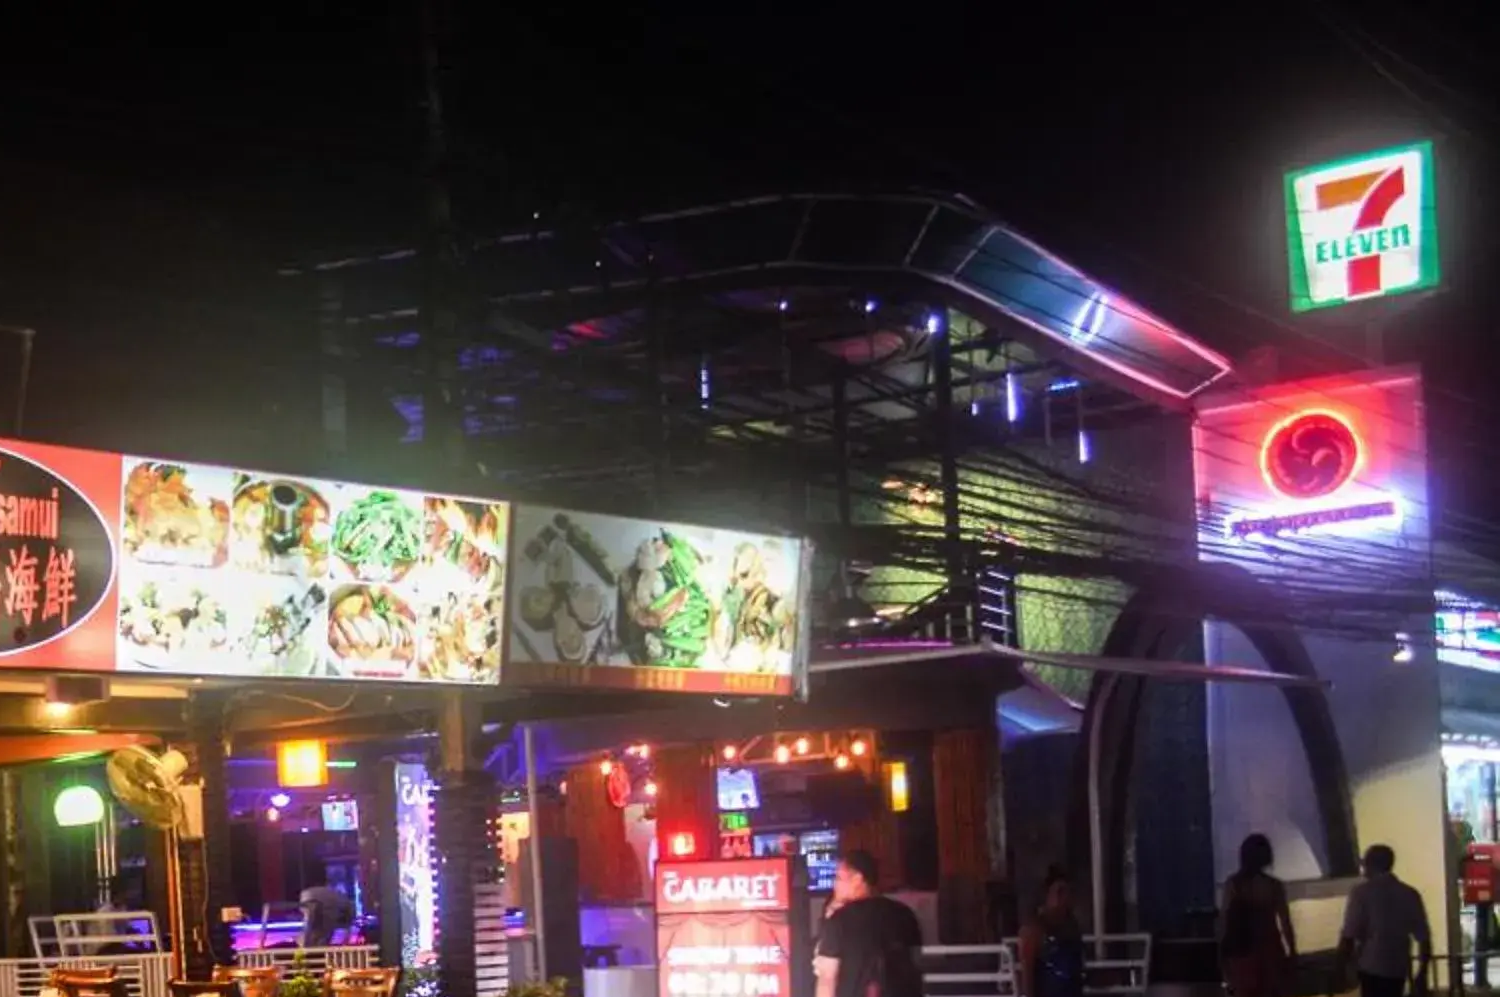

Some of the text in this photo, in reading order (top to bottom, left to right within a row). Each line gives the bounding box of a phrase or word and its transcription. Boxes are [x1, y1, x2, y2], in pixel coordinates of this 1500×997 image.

[1316, 165, 1405, 296] 7
[663, 876, 777, 902] CABARET
[745, 973, 779, 995] PM
